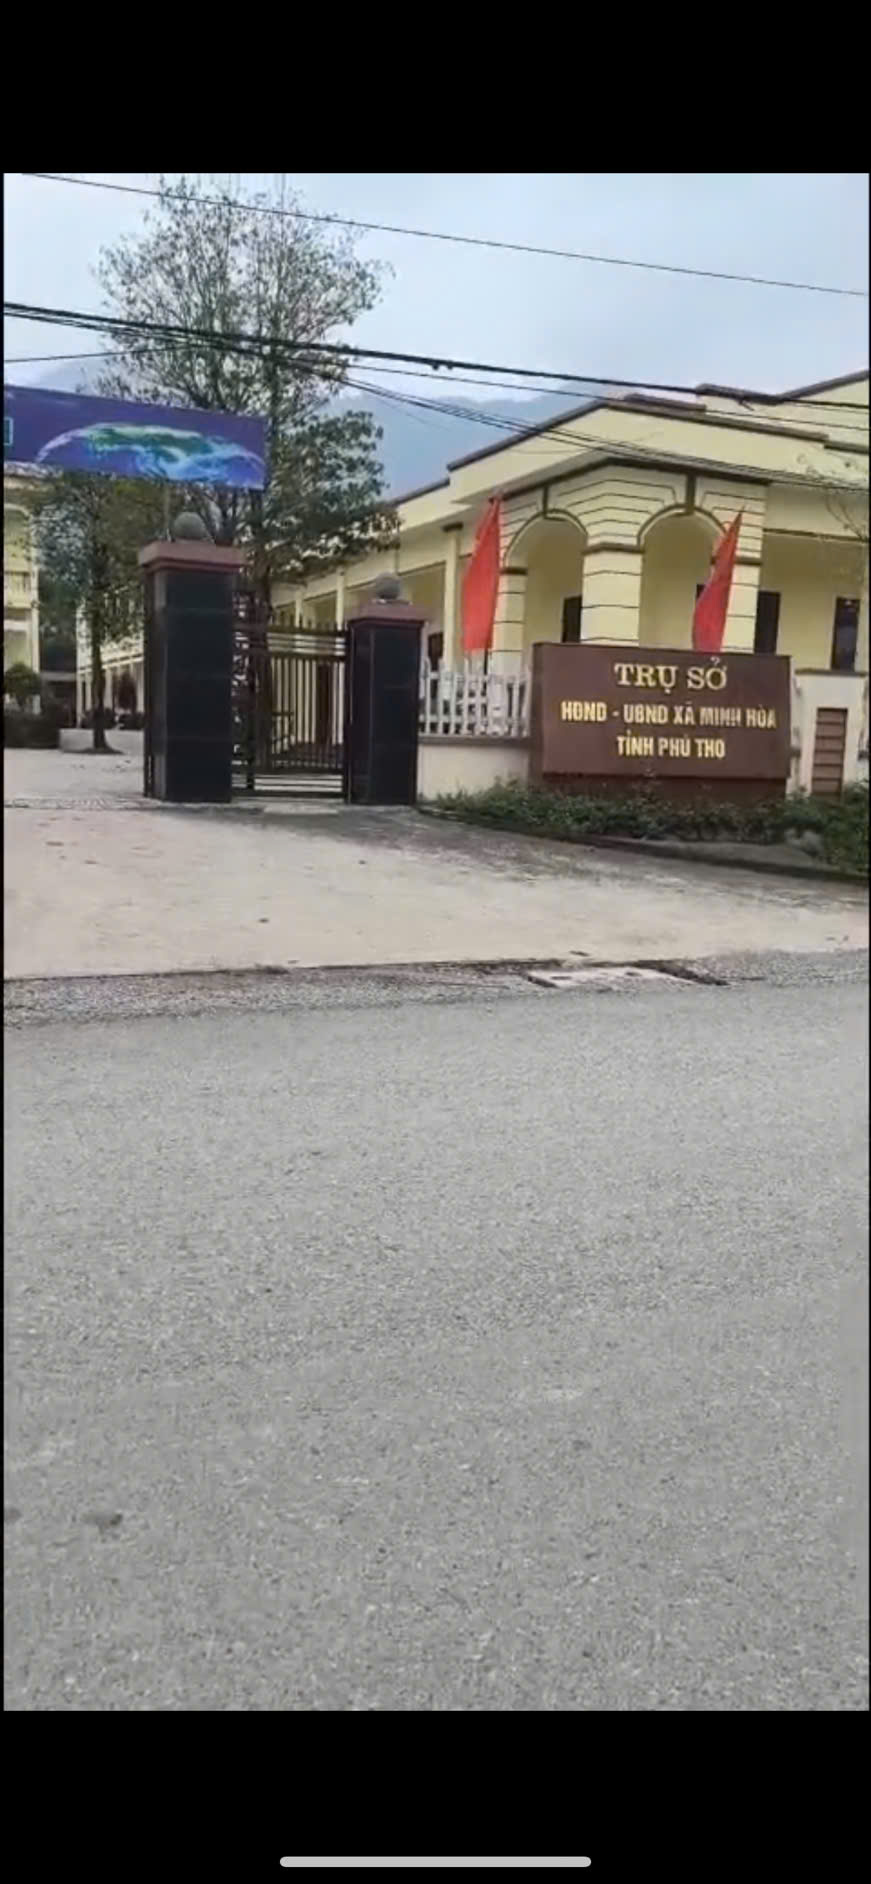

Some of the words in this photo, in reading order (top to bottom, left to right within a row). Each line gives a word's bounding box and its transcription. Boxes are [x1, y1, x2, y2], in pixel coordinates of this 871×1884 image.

[614, 662, 678, 694] TRỤ
[686, 656, 728, 690] SỞ
[623, 703, 669, 725] UBND
[673, 700, 695, 726] XÃ
[699, 706, 742, 726] MINH
[746, 704, 777, 728] HÒA
[616, 728, 654, 756] TỈNH
